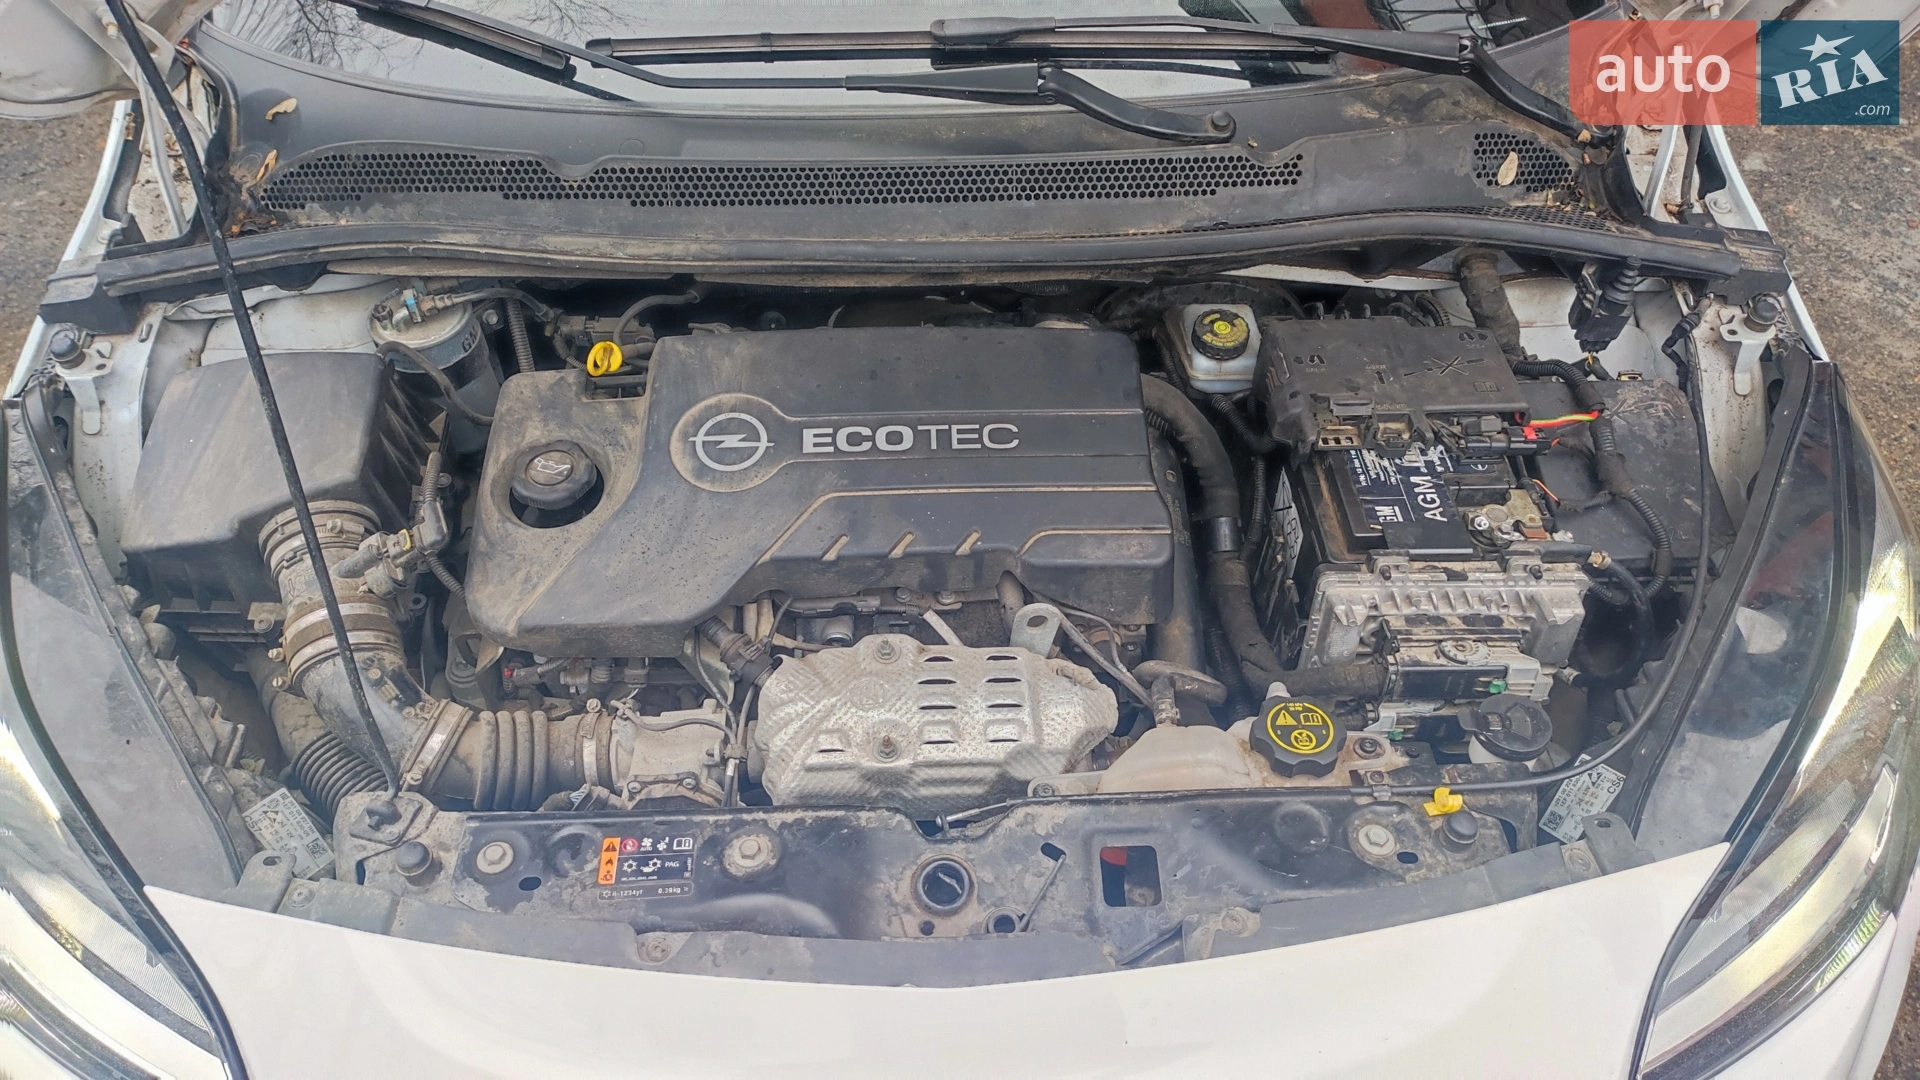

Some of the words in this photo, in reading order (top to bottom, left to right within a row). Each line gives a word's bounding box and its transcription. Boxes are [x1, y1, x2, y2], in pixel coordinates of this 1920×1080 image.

[802, 423, 1020, 453] ECOTEC
[1410, 475, 1448, 522] AGM
[1374, 505, 1399, 523] GM
[1606, 776, 1625, 794] CS6
[243, 815, 262, 833] CS7
